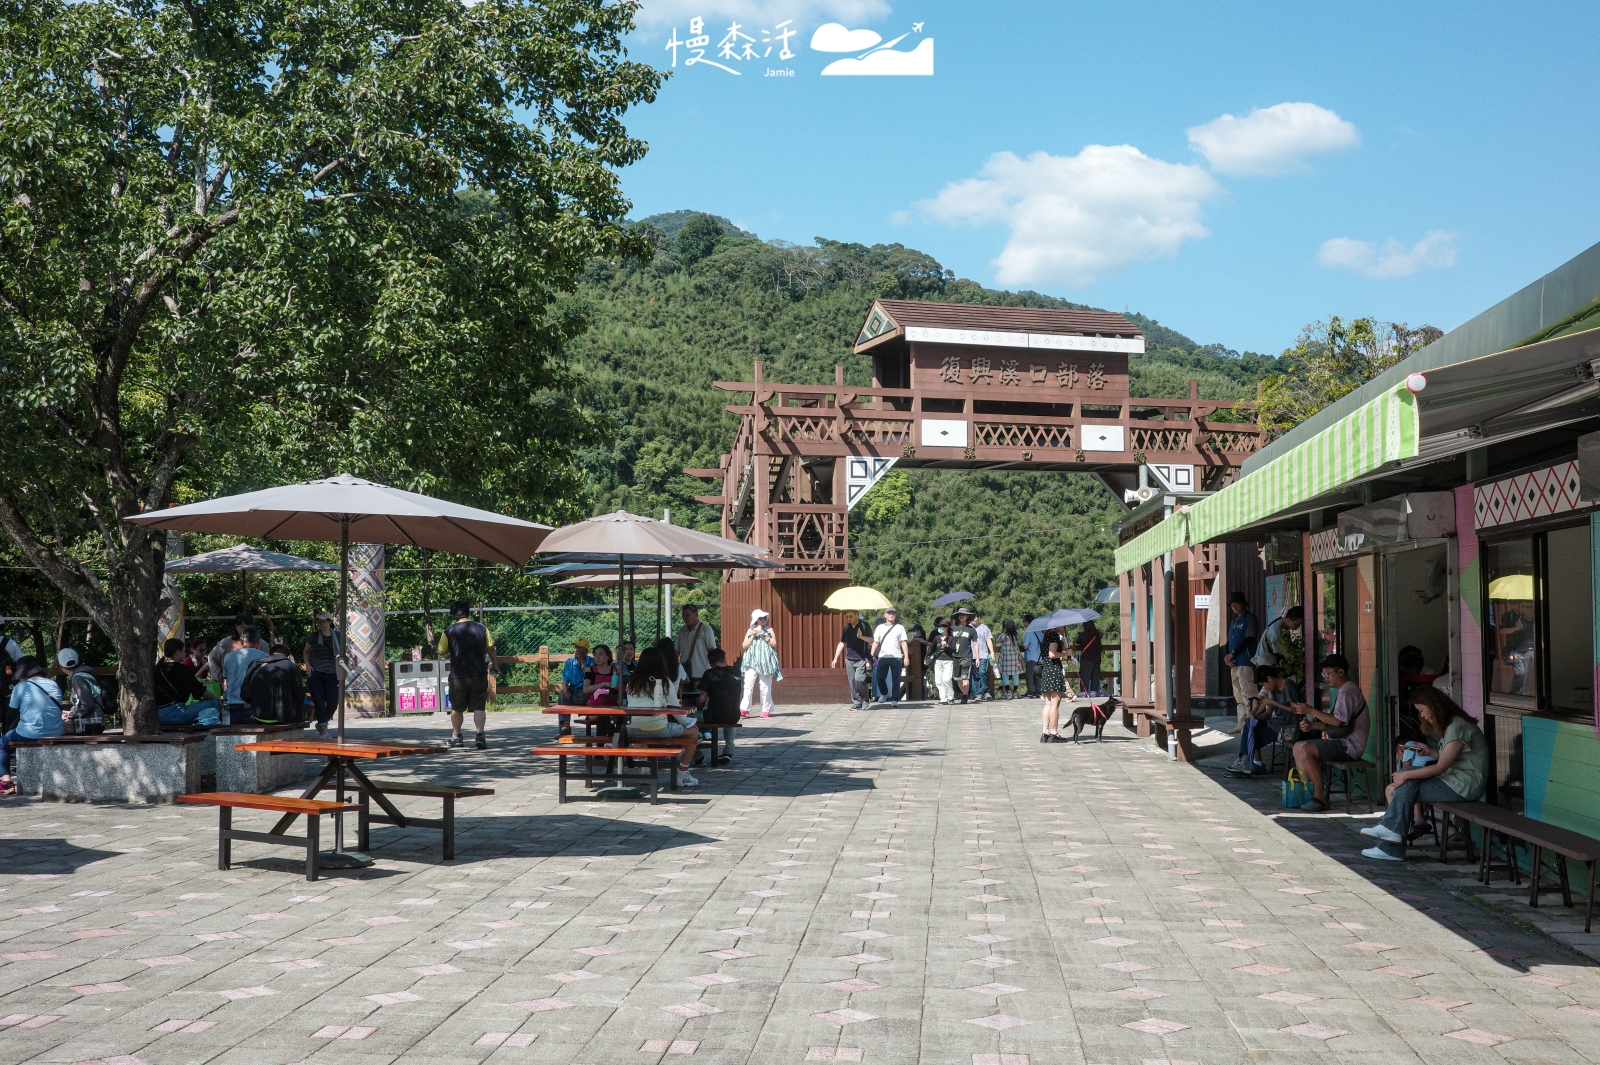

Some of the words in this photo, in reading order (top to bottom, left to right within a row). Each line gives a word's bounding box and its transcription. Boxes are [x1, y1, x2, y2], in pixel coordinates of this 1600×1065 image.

[939, 355, 1109, 391] 復興溪口部落
